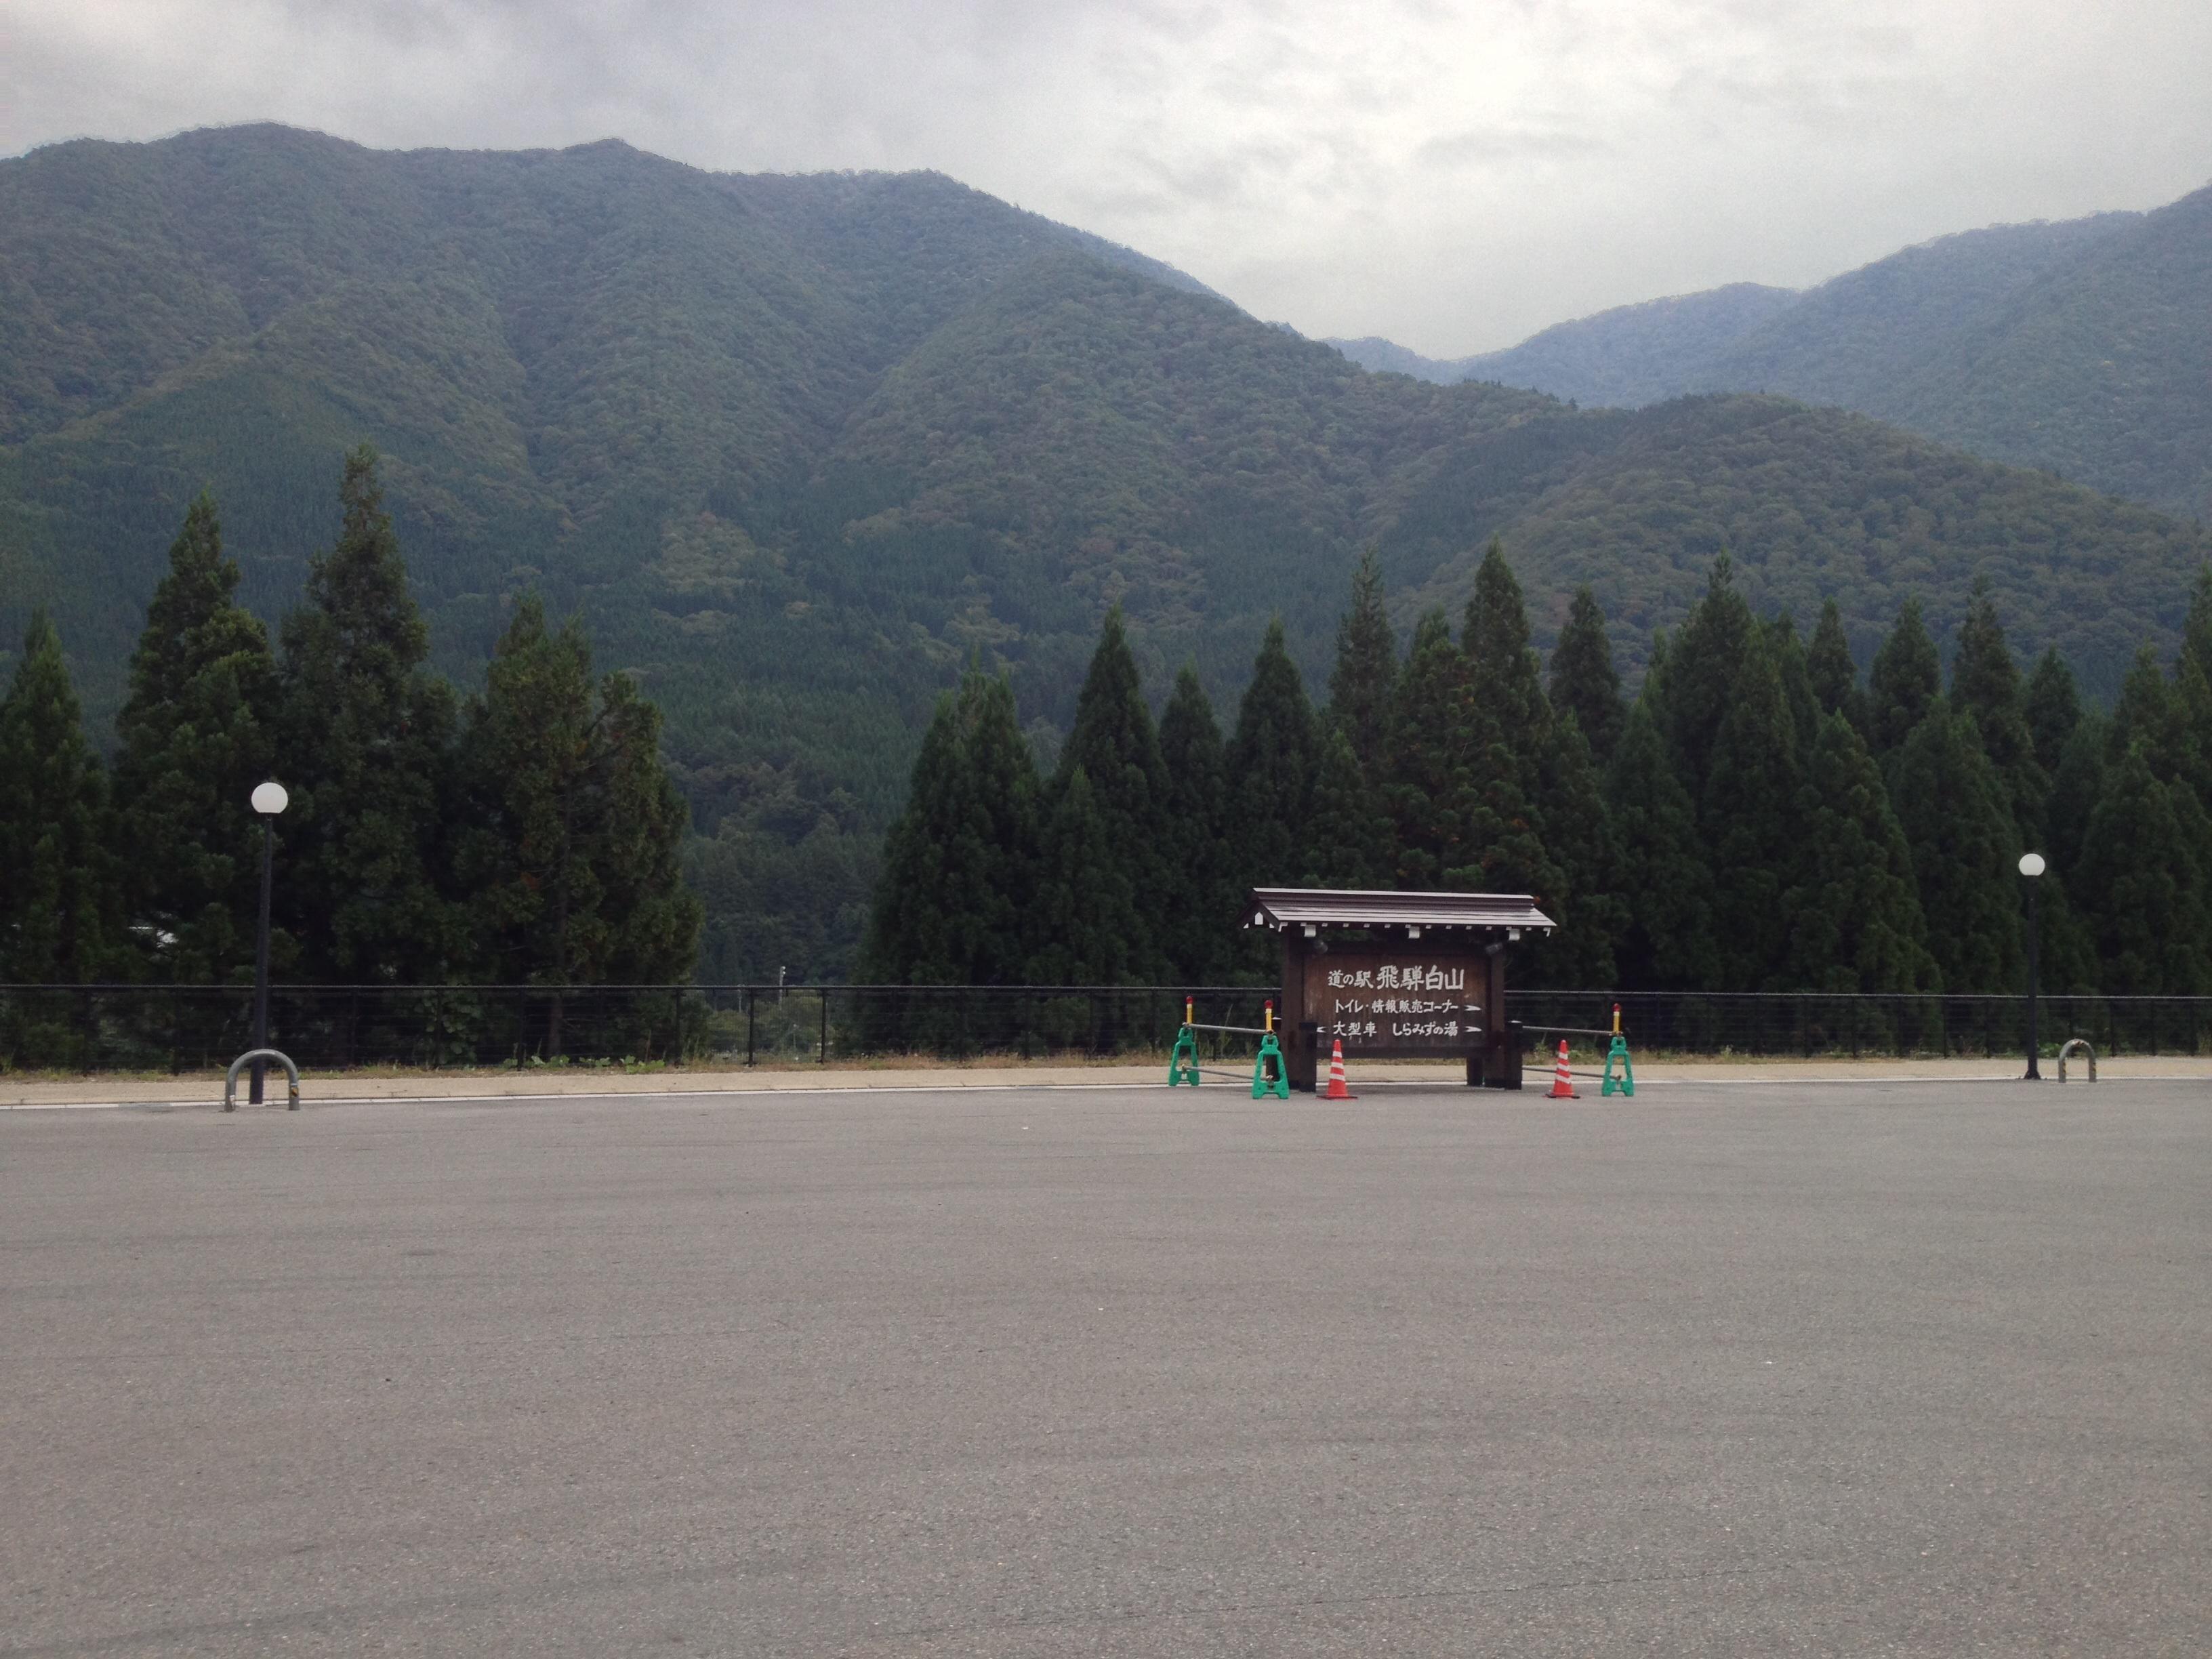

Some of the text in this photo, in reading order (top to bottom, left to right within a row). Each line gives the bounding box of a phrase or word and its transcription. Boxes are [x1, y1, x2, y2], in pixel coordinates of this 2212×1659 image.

[1328, 969, 1374, 989] 道の駅
[1333, 1021, 1458, 1038] 大型車 しらみずの湯
